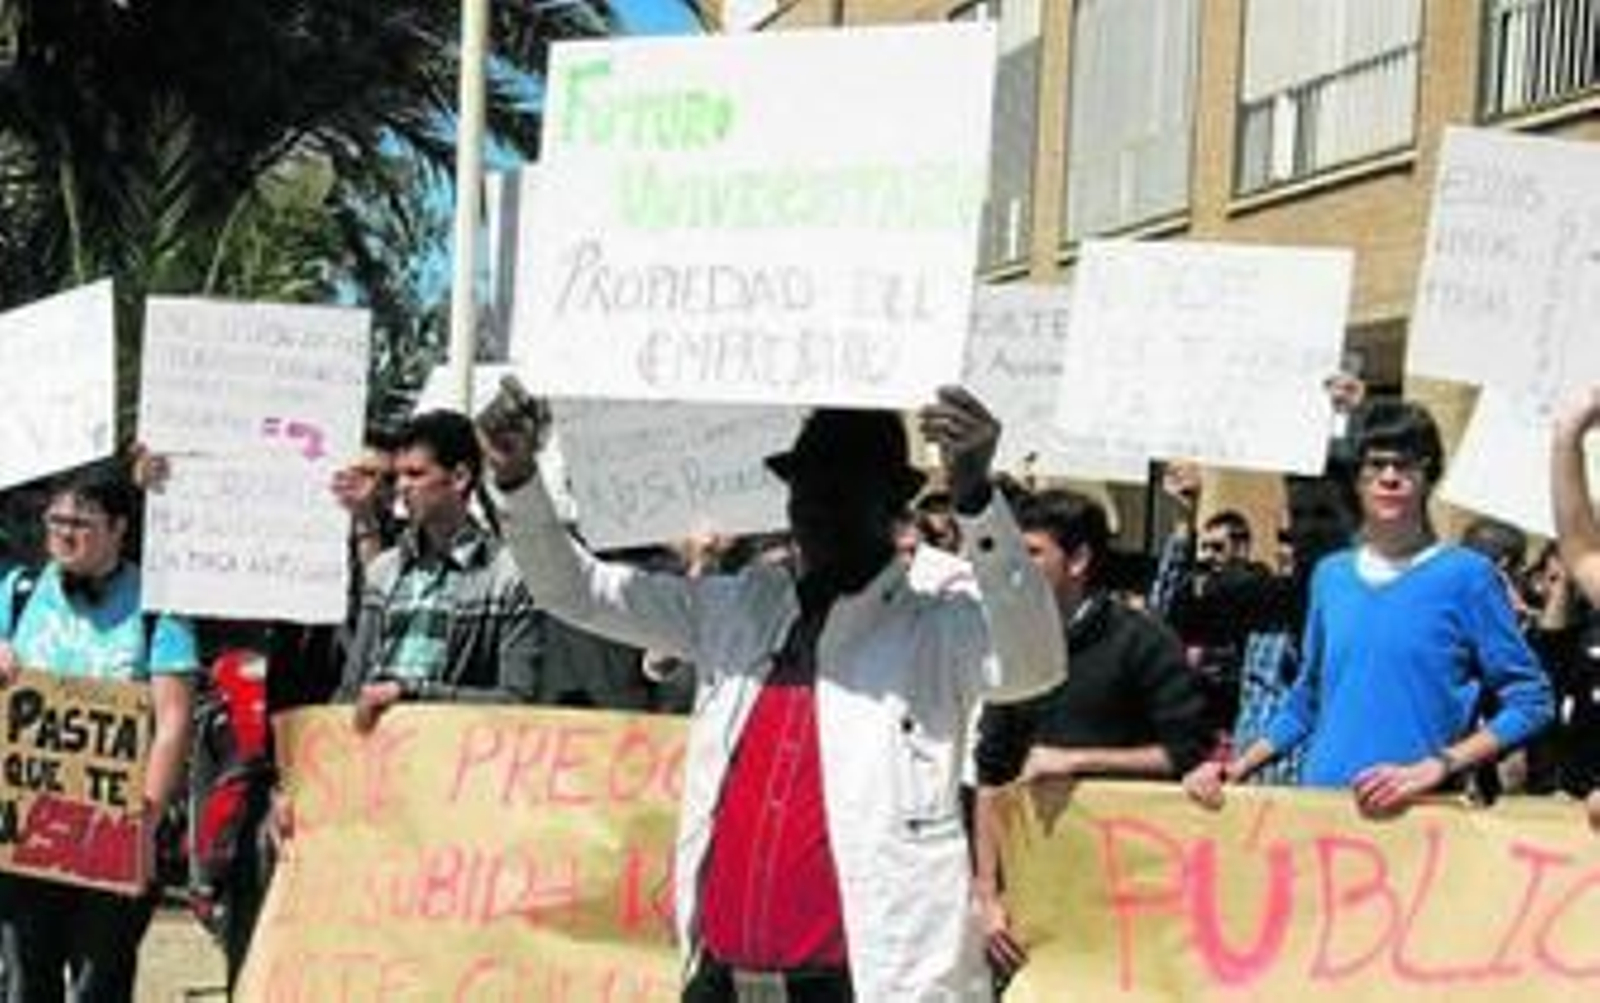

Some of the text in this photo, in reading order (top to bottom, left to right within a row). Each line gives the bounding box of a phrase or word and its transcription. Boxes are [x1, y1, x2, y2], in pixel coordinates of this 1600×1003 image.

[554, 236, 818, 316] PROPIEDAD
[7, 688, 138, 758] PASTA
[3, 752, 129, 806] QUE TE
